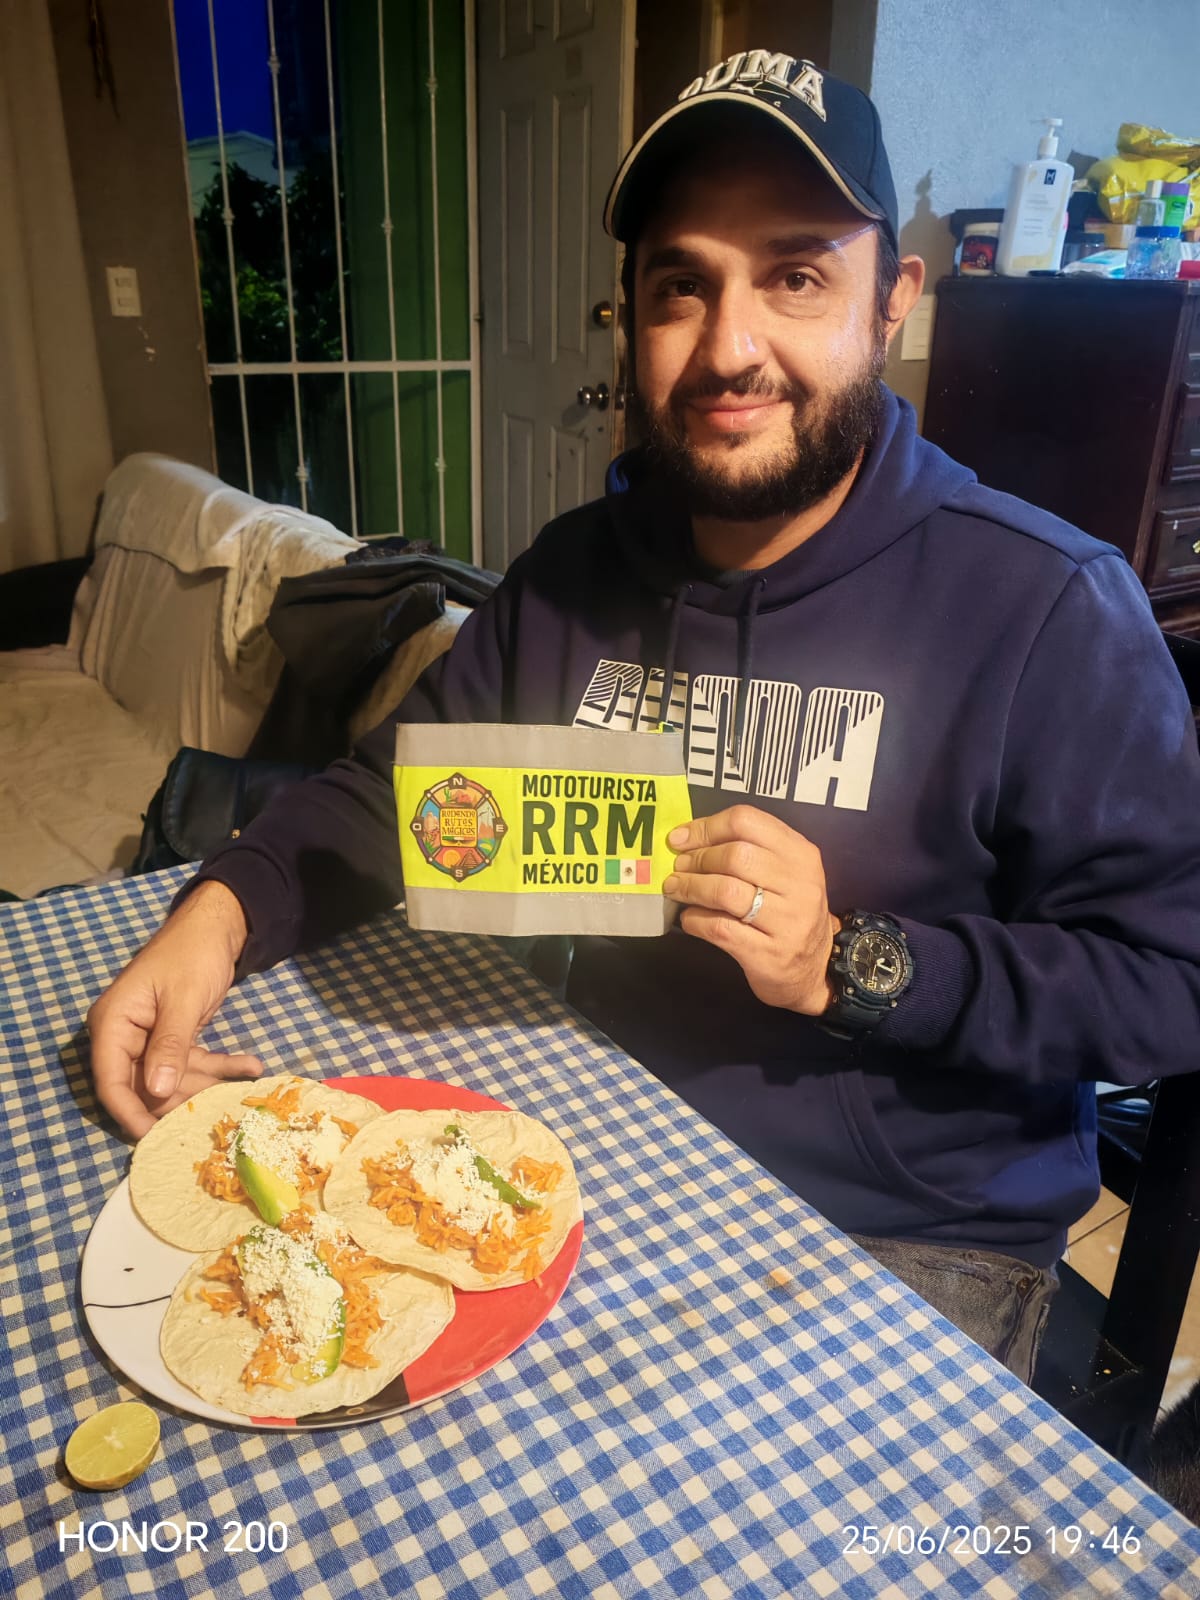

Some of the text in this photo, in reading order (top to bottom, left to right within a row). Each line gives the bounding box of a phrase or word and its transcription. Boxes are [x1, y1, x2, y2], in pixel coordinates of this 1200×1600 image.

[453, 777, 463, 786] N
[522, 774, 657, 802] MOTOTURISTA
[496, 824, 504, 833] E
[521, 800, 656, 857] RRM
[455, 869, 463, 878] S
[522, 859, 599, 885] MÉXICO
